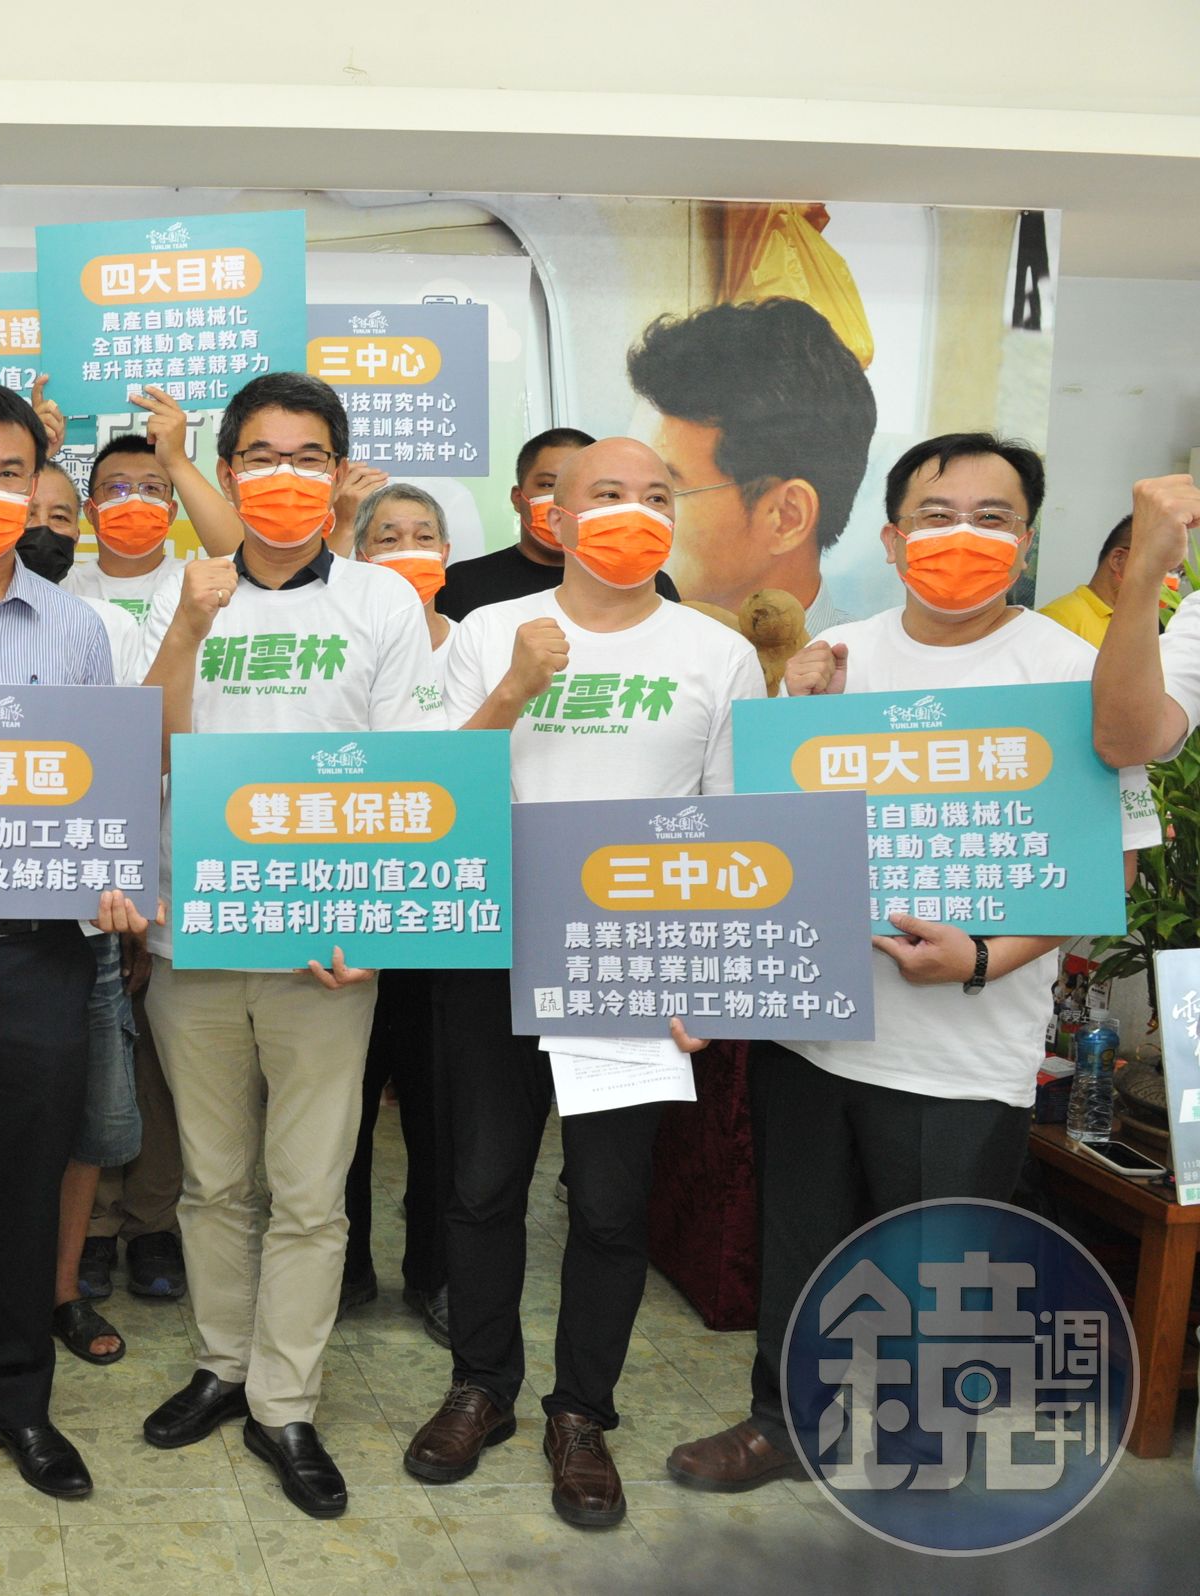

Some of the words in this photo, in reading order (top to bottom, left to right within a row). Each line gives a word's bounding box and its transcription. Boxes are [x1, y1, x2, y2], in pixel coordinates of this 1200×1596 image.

[100, 254, 247, 297] 四大目標
[102, 305, 249, 333] 農產自動機械化
[92, 329, 259, 358] 全面推動食農教育
[319, 342, 427, 379] 三中心
[82, 352, 270, 381] 提升蔬菜產業競爭力
[200, 633, 348, 683] 新雲林
[222, 685, 251, 695] NEW
[256, 685, 307, 695] YUNLIN
[533, 723, 566, 734] NEW
[571, 725, 629, 735] YUNLIN
[820, 735, 1030, 786] 四大目標
[249, 791, 433, 836] 雙重保證
[194, 857, 488, 893] 農民年收加值20萬
[608, 851, 768, 900] 三中心
[181, 898, 502, 934] 農民福利措施全到位
[564, 920, 820, 951] 農業科技研究中心
[565, 954, 821, 985] 青農專業訓練中心
